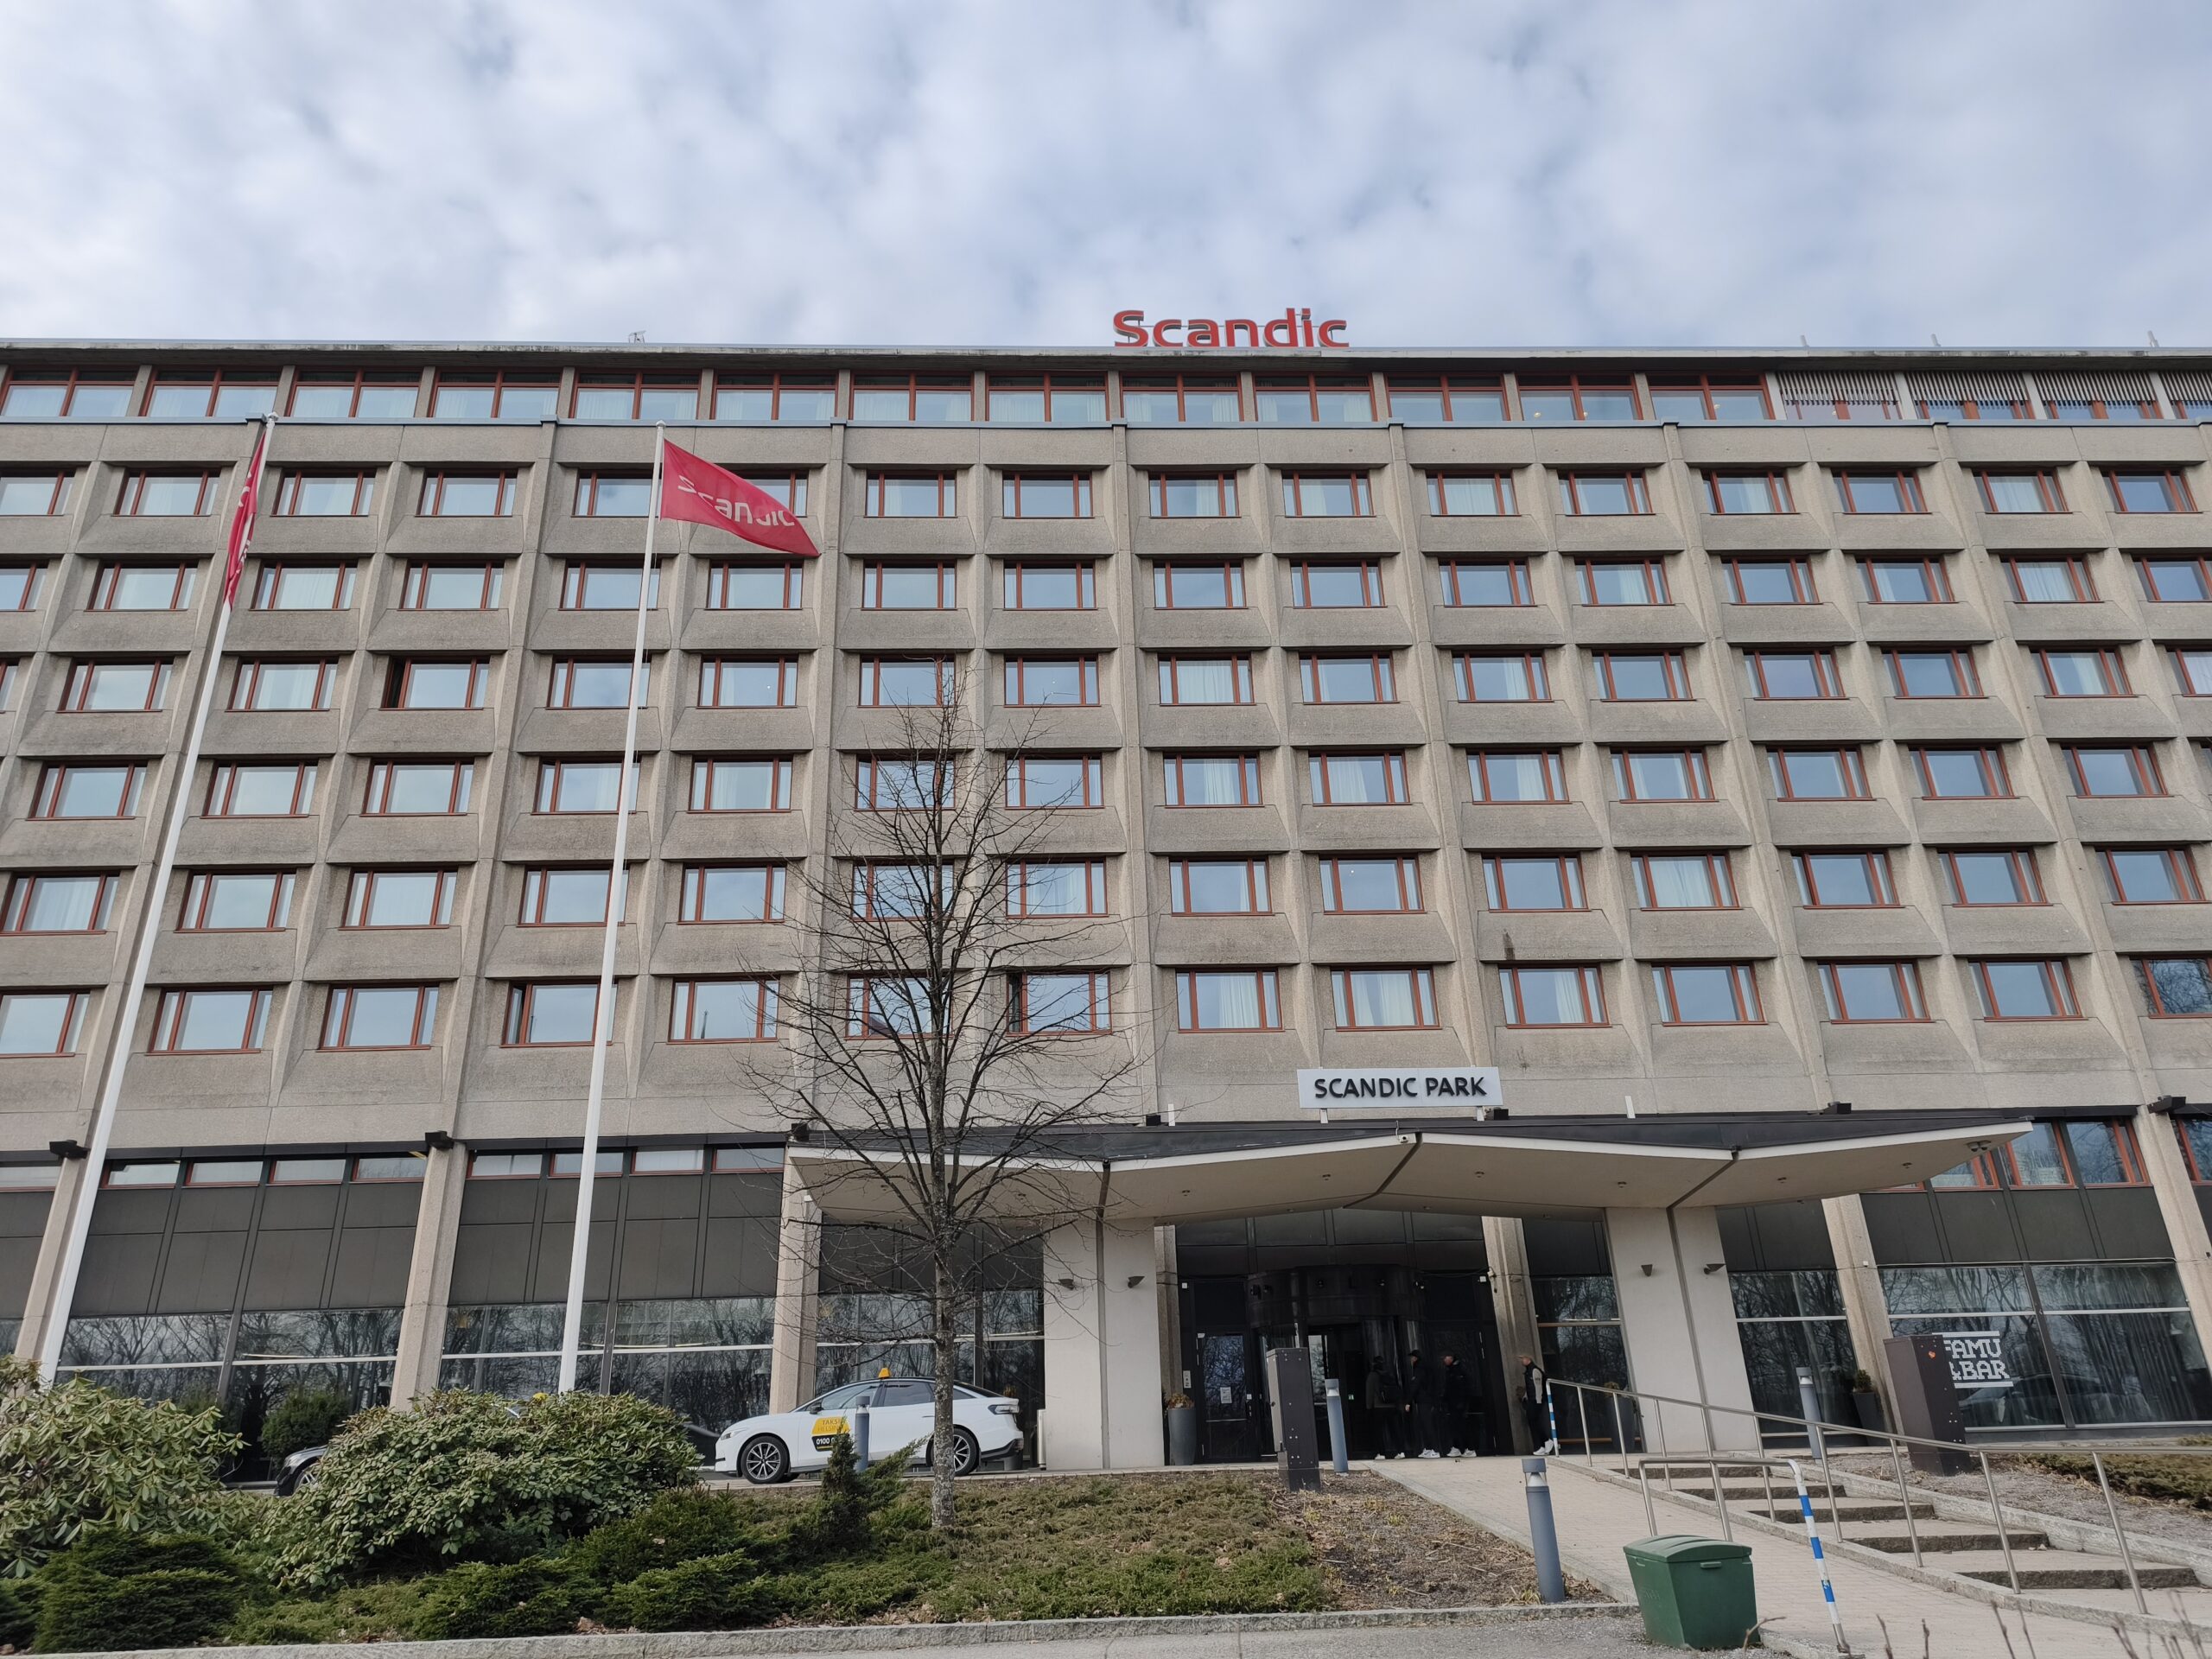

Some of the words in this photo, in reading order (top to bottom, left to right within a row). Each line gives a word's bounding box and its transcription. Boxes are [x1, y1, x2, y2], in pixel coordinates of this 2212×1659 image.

[1113, 308, 1350, 347] Scandic
[1314, 1077, 1418, 1098] SCANDIC
[1426, 1077, 1487, 1096] PARK
